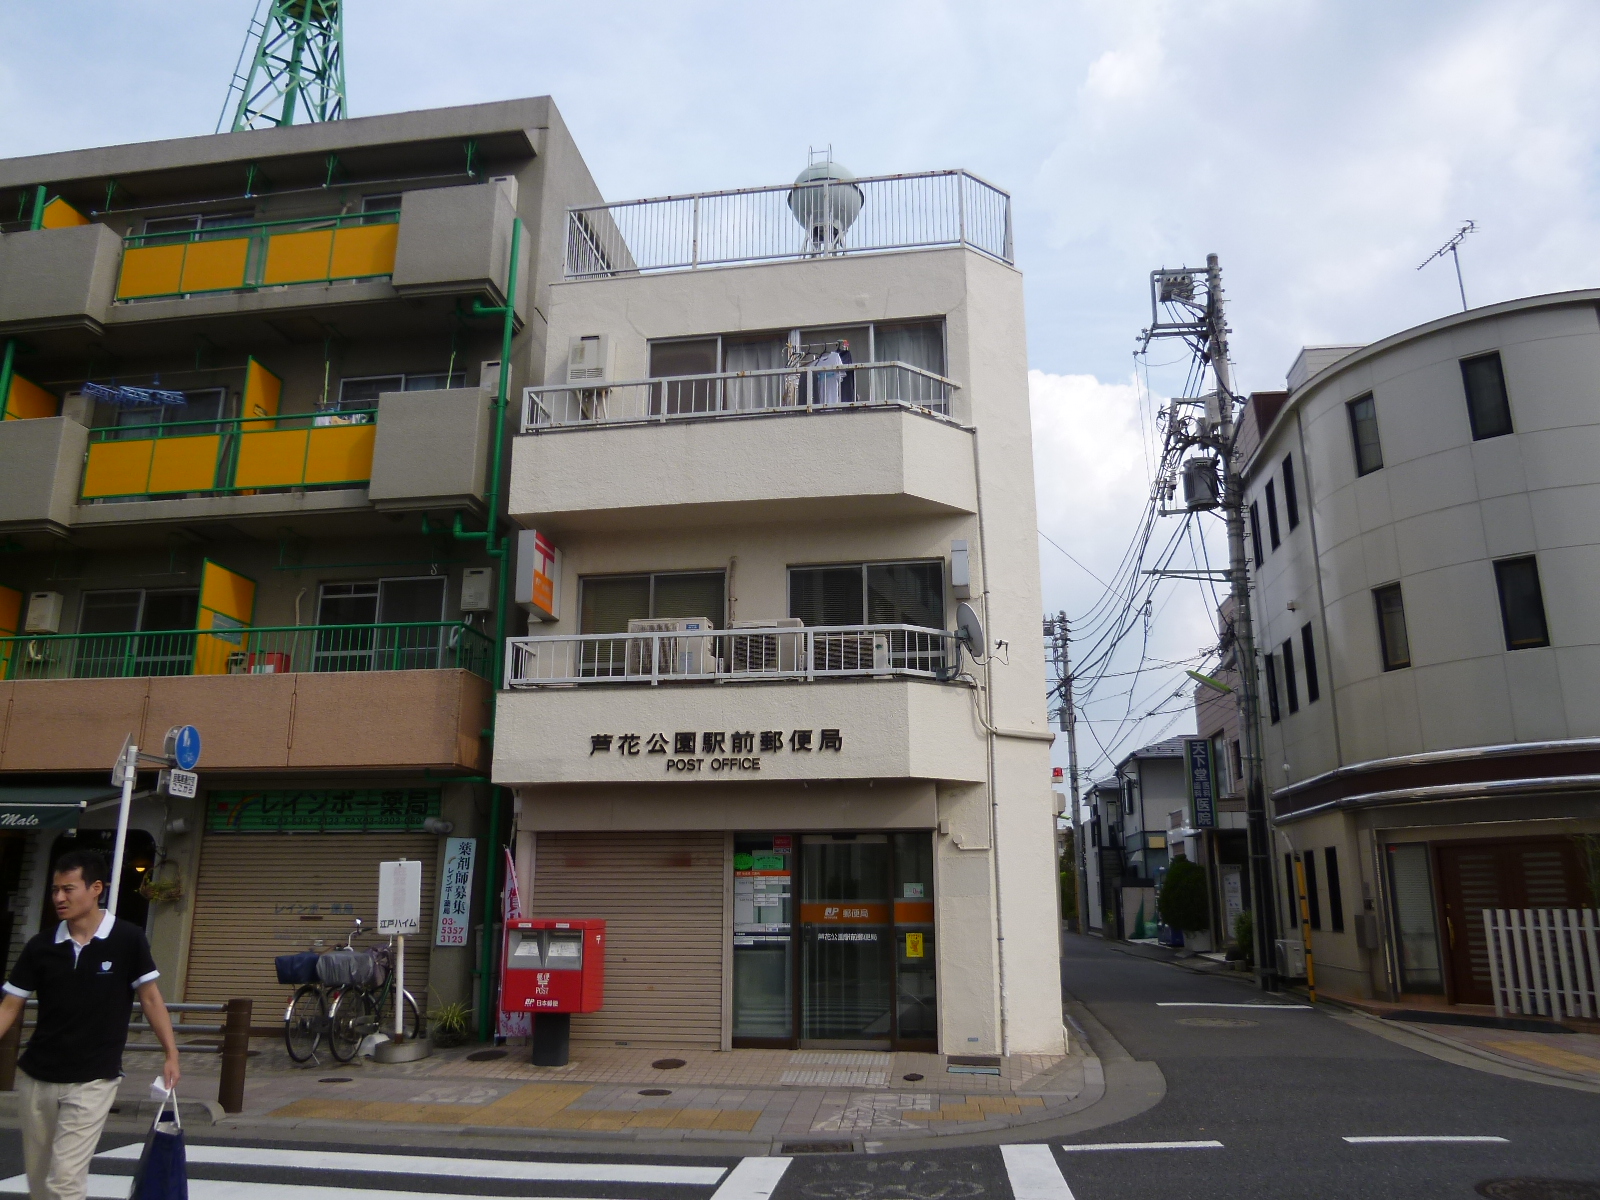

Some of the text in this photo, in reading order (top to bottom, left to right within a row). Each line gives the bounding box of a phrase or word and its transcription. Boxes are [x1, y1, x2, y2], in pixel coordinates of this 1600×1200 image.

[590, 729, 842, 756] 芦花公園駅前郵便局
[667, 758, 761, 771] POST OFFICE
[172, 782, 194, 794] ここから
[261, 790, 429, 816] レインボー薬局
[1, 813, 39, 826] Malo
[453, 842, 472, 915] 薬剤師募集
[443, 867, 454, 914] レインボー薬局
[843, 908, 868, 918] 郵便局
[380, 919, 416, 928] 江戸ハイム
[440, 935, 464, 943] 3123
